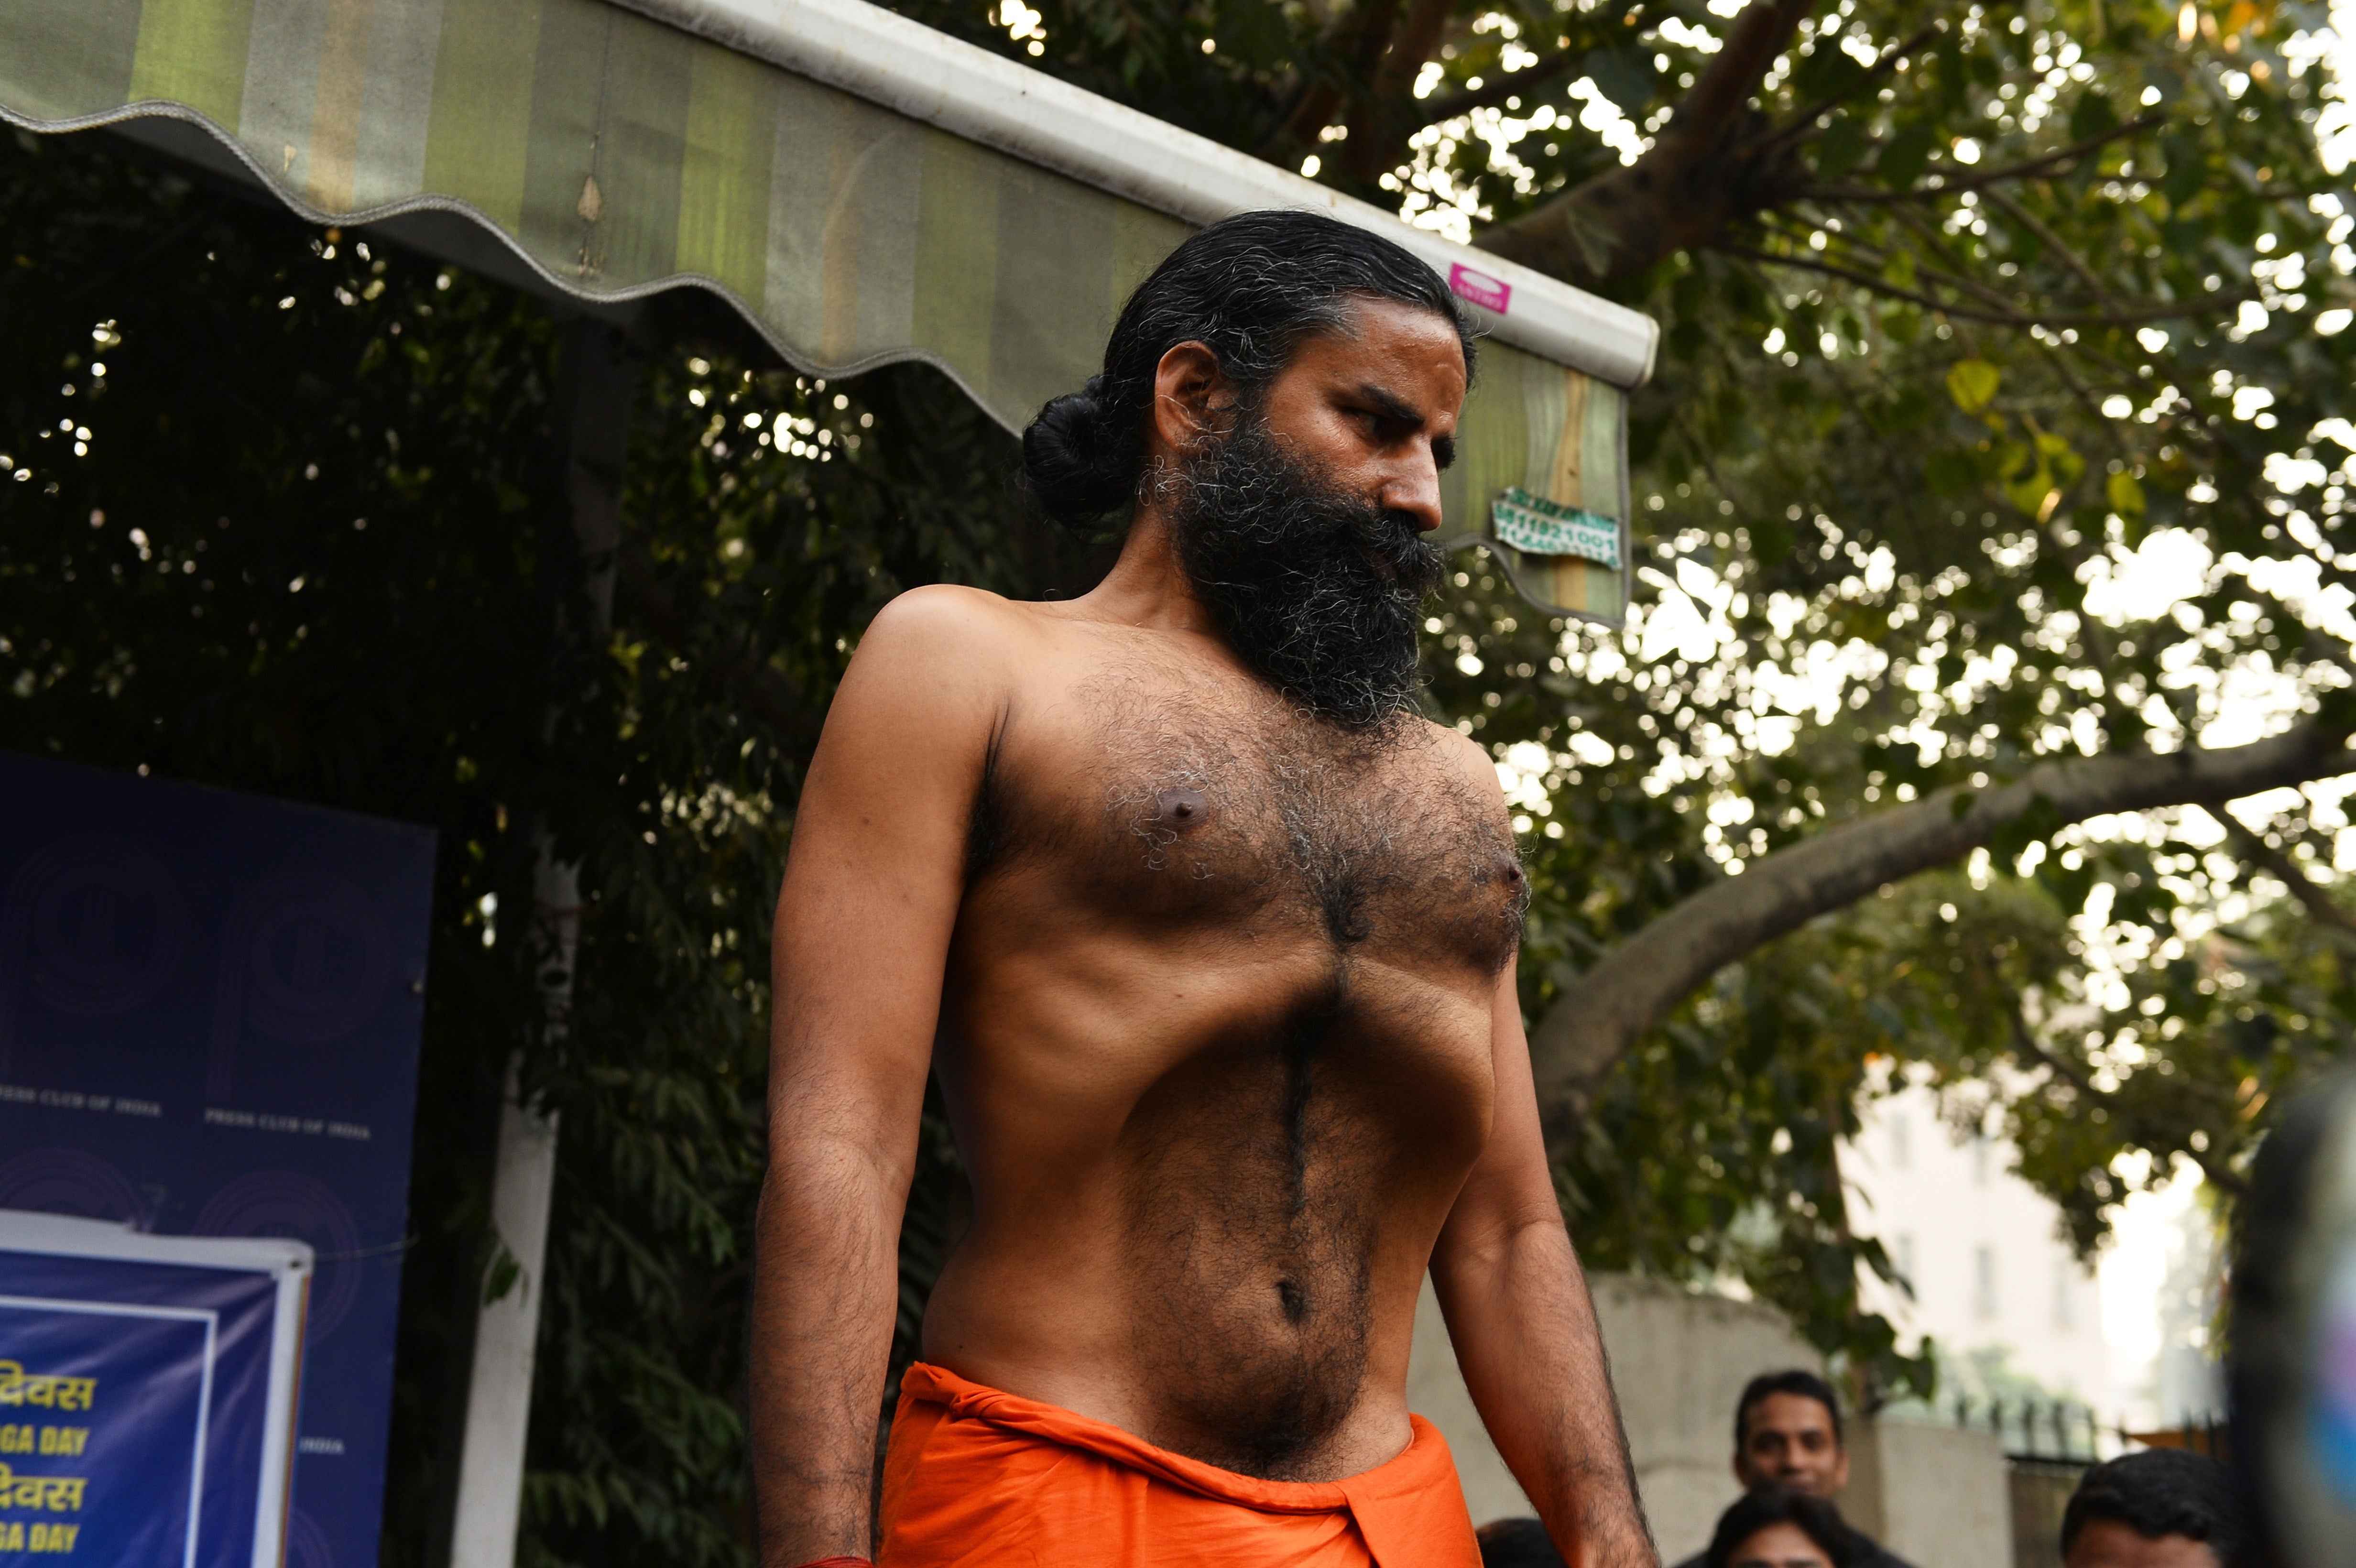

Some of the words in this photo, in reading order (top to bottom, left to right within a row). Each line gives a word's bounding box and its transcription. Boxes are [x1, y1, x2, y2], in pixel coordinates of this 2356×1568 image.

[40, 1090, 86, 1109] CLUB
[88, 1095, 111, 1111] OF
[115, 1099, 161, 1118] INDIA
[205, 1108, 255, 1128] PRESS
[258, 1114, 300, 1132] CLUB
[303, 1119, 324, 1134] OF
[327, 1122, 371, 1139] INDIA
[39, 1426, 90, 1456] DAY
[29, 1523, 80, 1552] DAY
